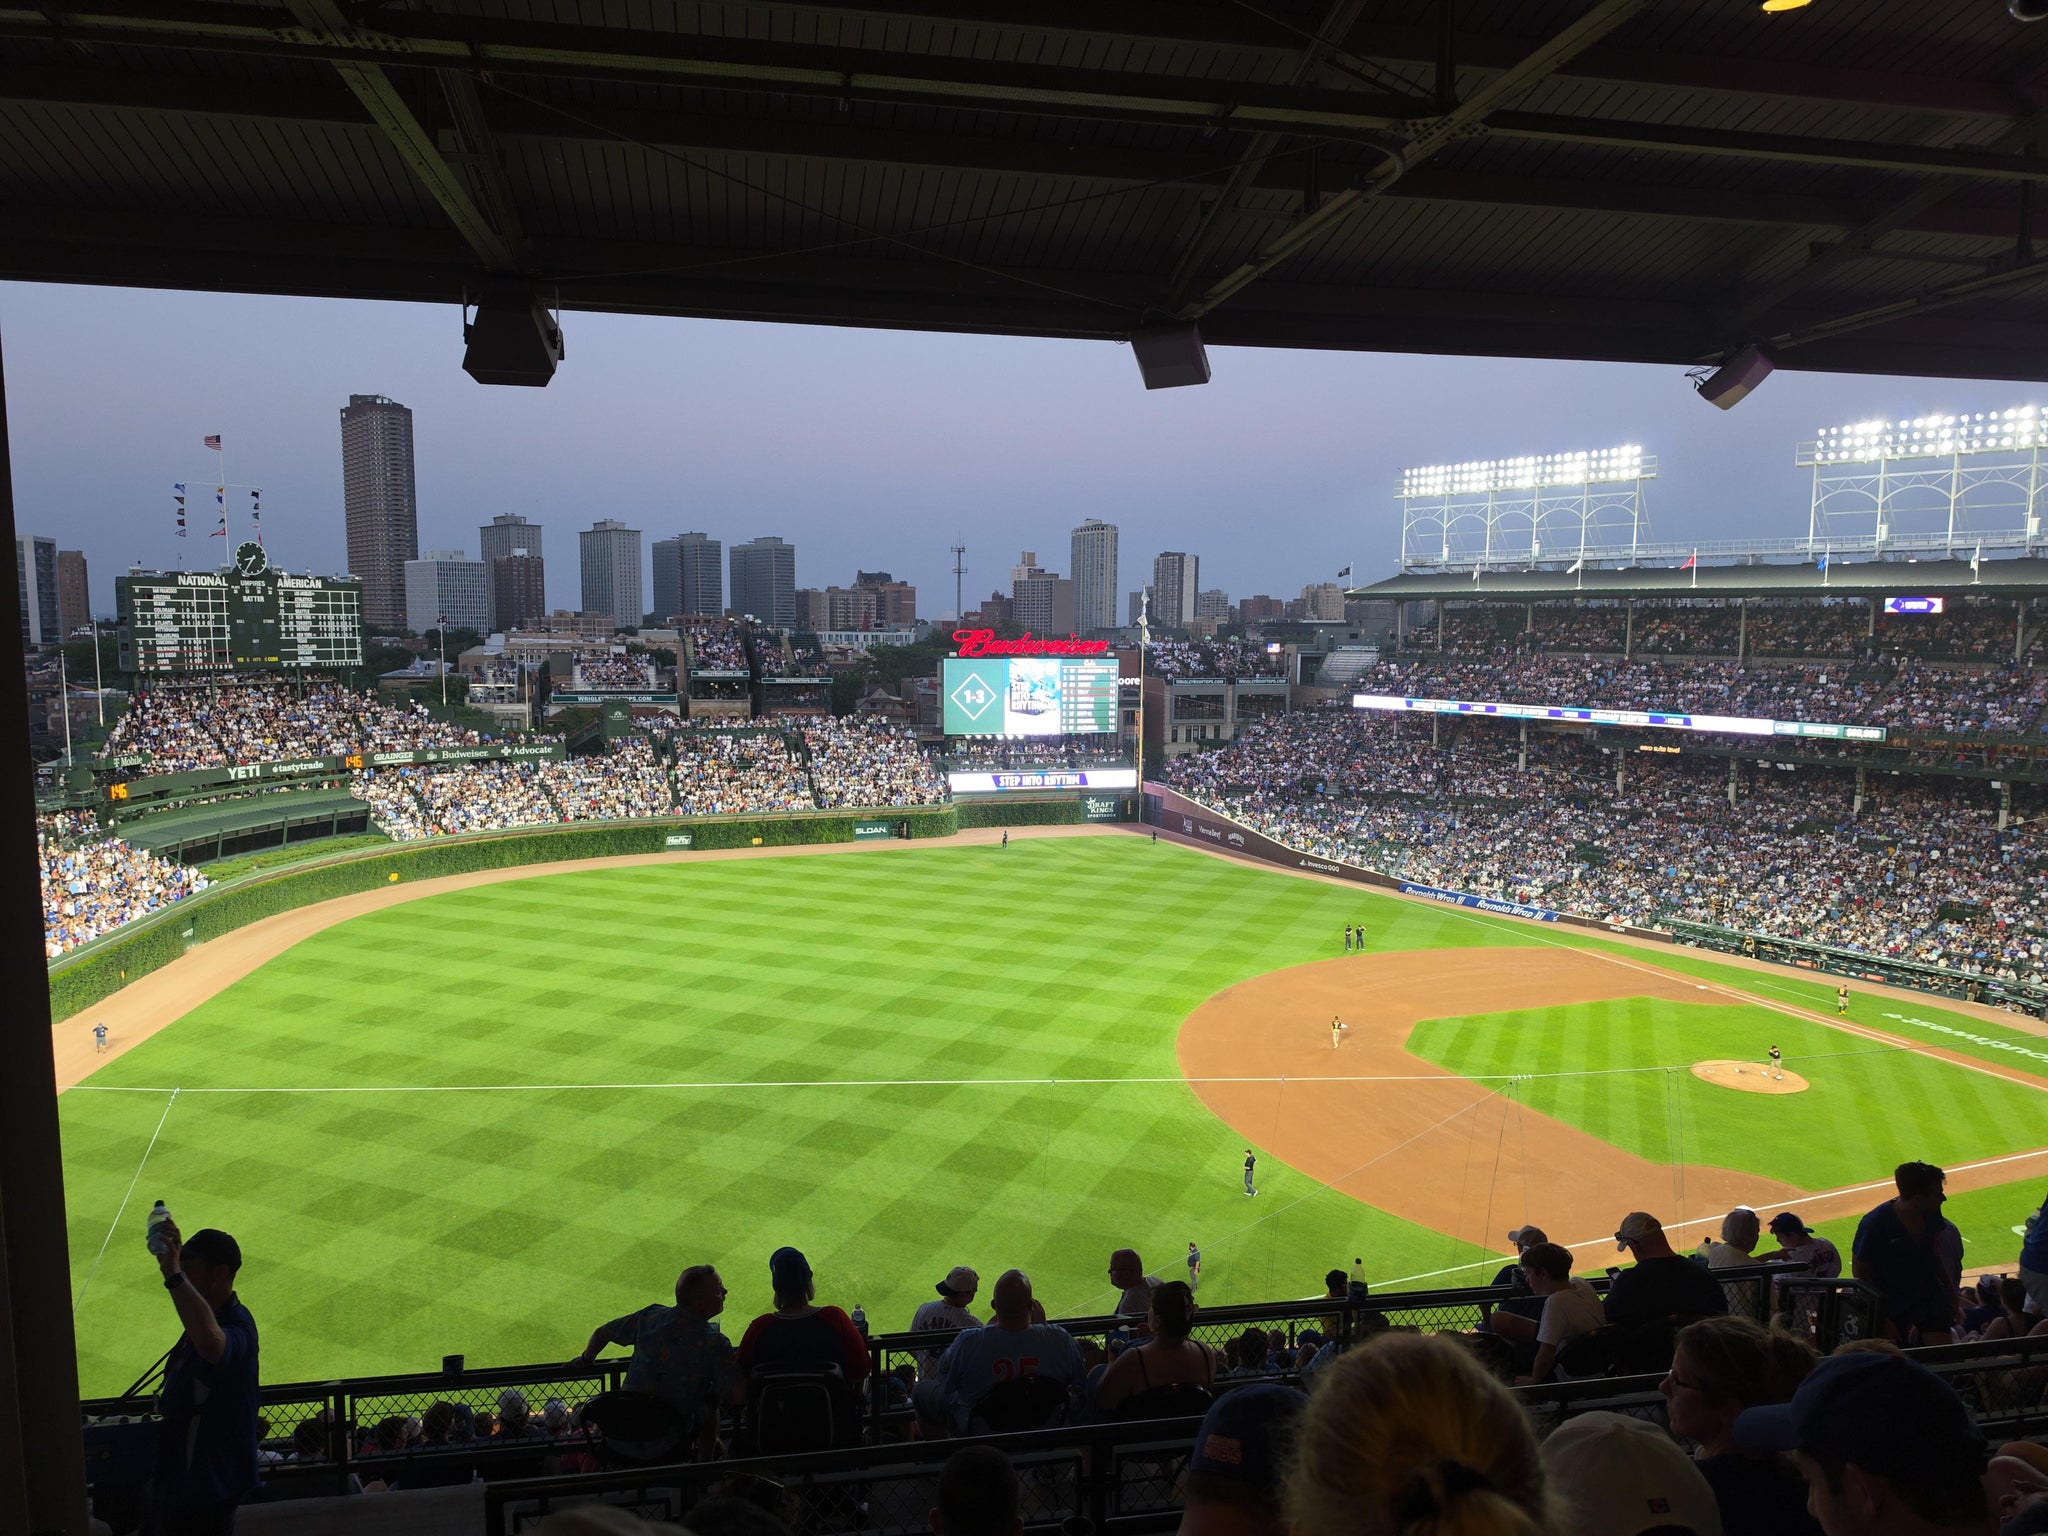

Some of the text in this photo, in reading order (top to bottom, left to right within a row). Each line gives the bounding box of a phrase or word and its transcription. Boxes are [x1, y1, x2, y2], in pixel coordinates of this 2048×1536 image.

[178, 575, 228, 586] NATIONAL
[277, 578, 322, 588] AMERICAN
[953, 628, 1109, 657] Budweiser
[1118, 677, 1141, 686] oore
[963, 689, 985, 704] 1-3
[373, 751, 414, 761] GRAINGER
[442, 750, 488, 759] Budweiser
[513, 746, 552, 755] Advocate
[121, 756, 143, 766] Mobile
[278, 760, 324, 773] tastytrade
[227, 764, 261, 780] YETI
[999, 775, 1020, 787] STEP
[1022, 774, 1043, 786] INTO
[1088, 801, 1115, 809] DRAFT
[668, 836, 690, 845] Hefty
[1307, 860, 1340, 872] Invesco QQQ
[1405, 886, 1436, 900] Reynolds
[1477, 900, 1512, 914] Reynolds
[1512, 905, 1534, 919] Wrap
